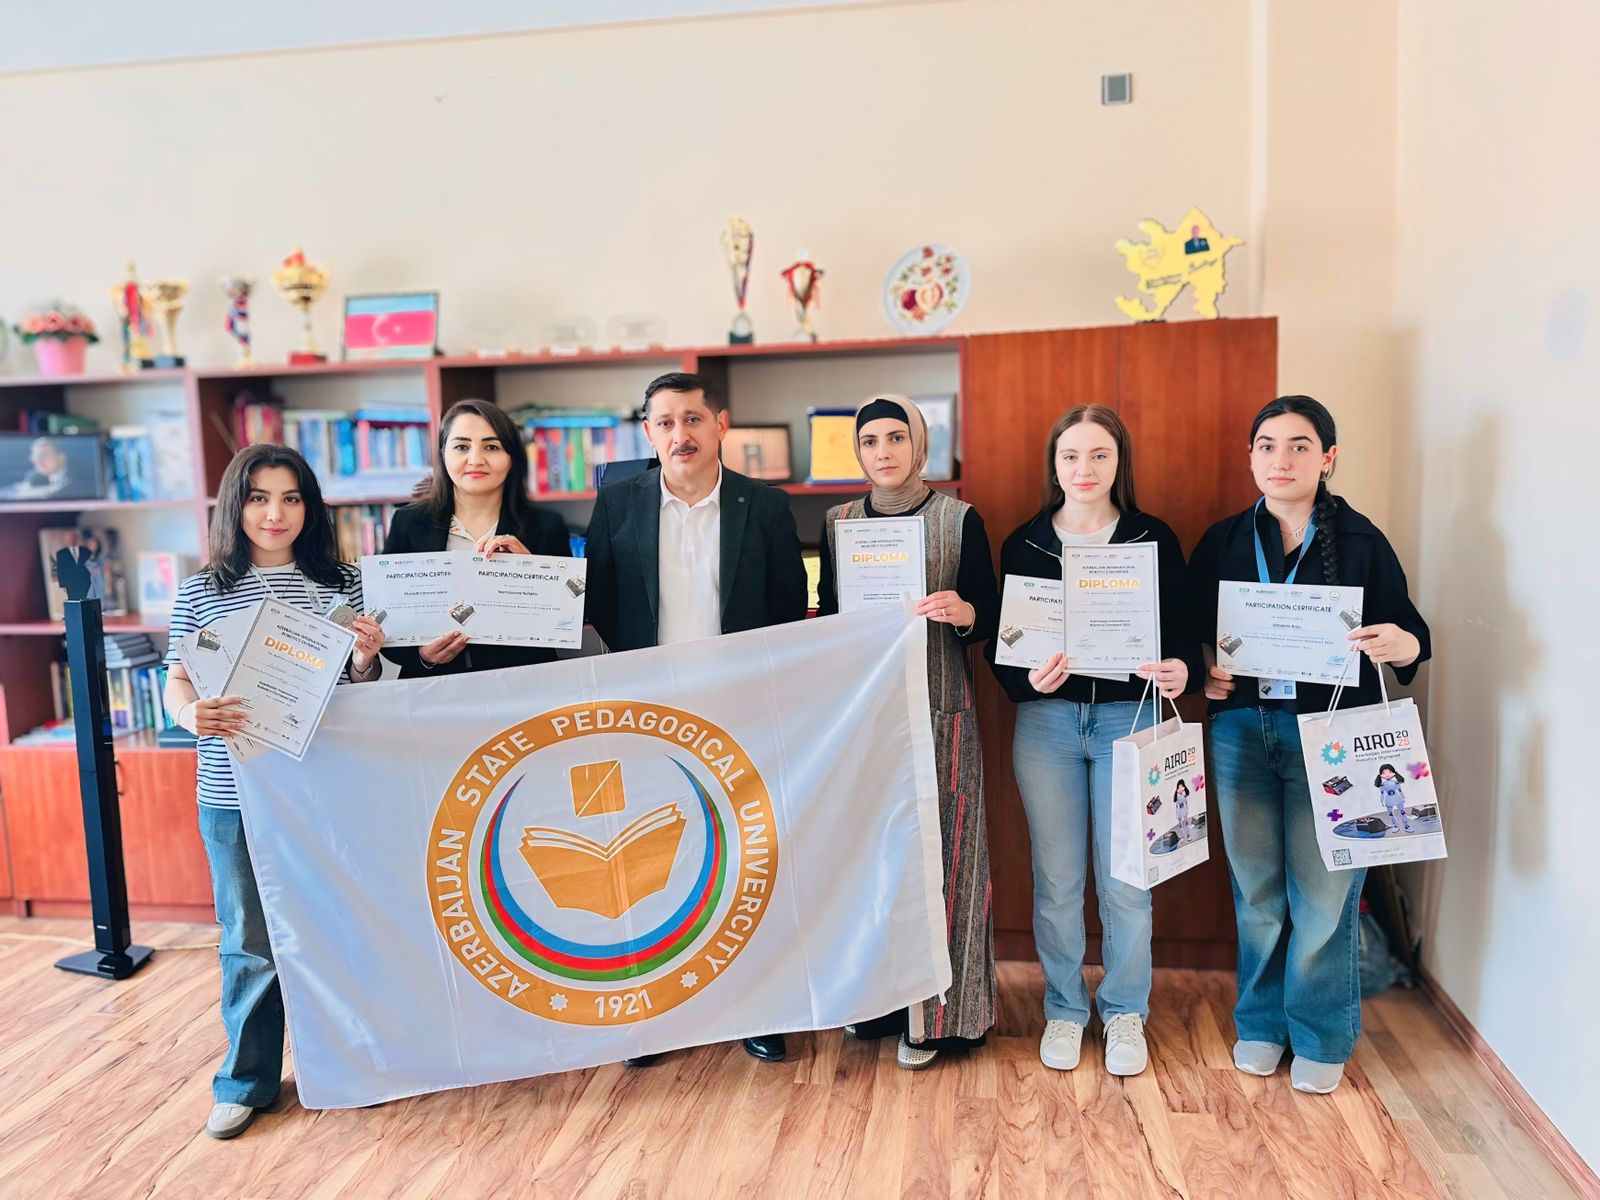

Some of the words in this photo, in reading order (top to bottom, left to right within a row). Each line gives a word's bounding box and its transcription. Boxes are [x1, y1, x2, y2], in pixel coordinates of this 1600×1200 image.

[852, 552, 908, 563] DIPLOMA
[478, 570, 523, 579] PARTICIPATION
[523, 573, 560, 581] CERTIFICATE
[1079, 579, 1140, 589] DIPLOMA
[1029, 596, 1063, 604] PARTICIPATI
[1245, 602, 1292, 610] PARTICIPATION
[1292, 604, 1332, 613] CERTIFICATE
[264, 636, 325, 670] DIPLOMA
[550, 708, 746, 792] PEDAGOGICAL
[1353, 732, 1395, 752] AIRO
[1396, 730, 1409, 739] 20
[1398, 738, 1410, 747] 25
[456, 730, 535, 807] STATE
[1164, 750, 1187, 771] AIRO
[704, 800, 770, 974] UNIVERCITY
[436, 828, 531, 999] AZERBAIJAN
[594, 989, 653, 1018] 1921
